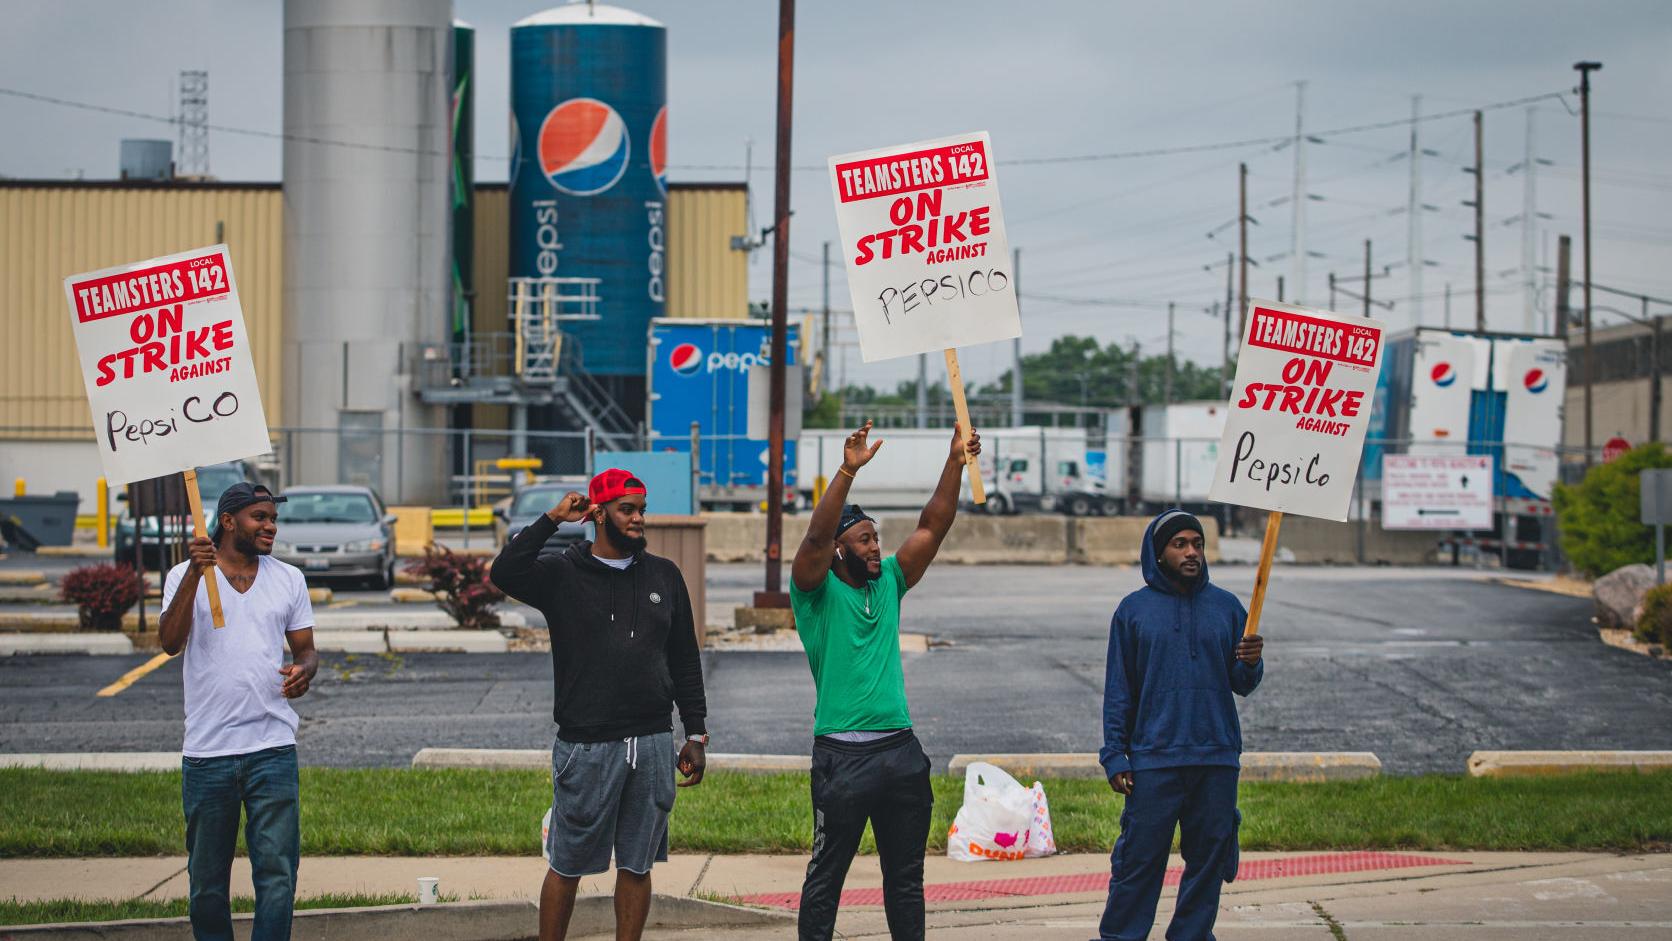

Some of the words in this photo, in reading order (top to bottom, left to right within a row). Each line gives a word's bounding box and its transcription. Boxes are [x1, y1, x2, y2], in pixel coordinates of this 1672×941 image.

[950, 144, 975, 154] LOCAL
[841, 154, 945, 197] TEAMSTERS
[948, 152, 985, 180] 142
[889, 188, 943, 227] ON
[644, 200, 665, 303] pepsi
[854, 206, 991, 267] STRIKE
[926, 241, 987, 265] AGAINST
[190, 257, 214, 268] LOCAL
[78, 269, 185, 316] TEAMSTERS
[187, 265, 226, 294] 142
[877, 268, 1008, 325] PEPSICO
[129, 303, 184, 345] ON
[1255, 314, 1344, 356] TEAMSTERS
[1346, 335, 1376, 362] 142
[1352, 327, 1373, 337] LOCAL
[95, 319, 234, 387] STRIKE
[170, 356, 232, 383] AGAINST
[707, 352, 772, 374] peps
[1281, 357, 1334, 387] ON
[1238, 382, 1365, 418] STRIKE
[1296, 416, 1351, 437] AGAINST
[1229, 430, 1330, 492] PepsiCo
